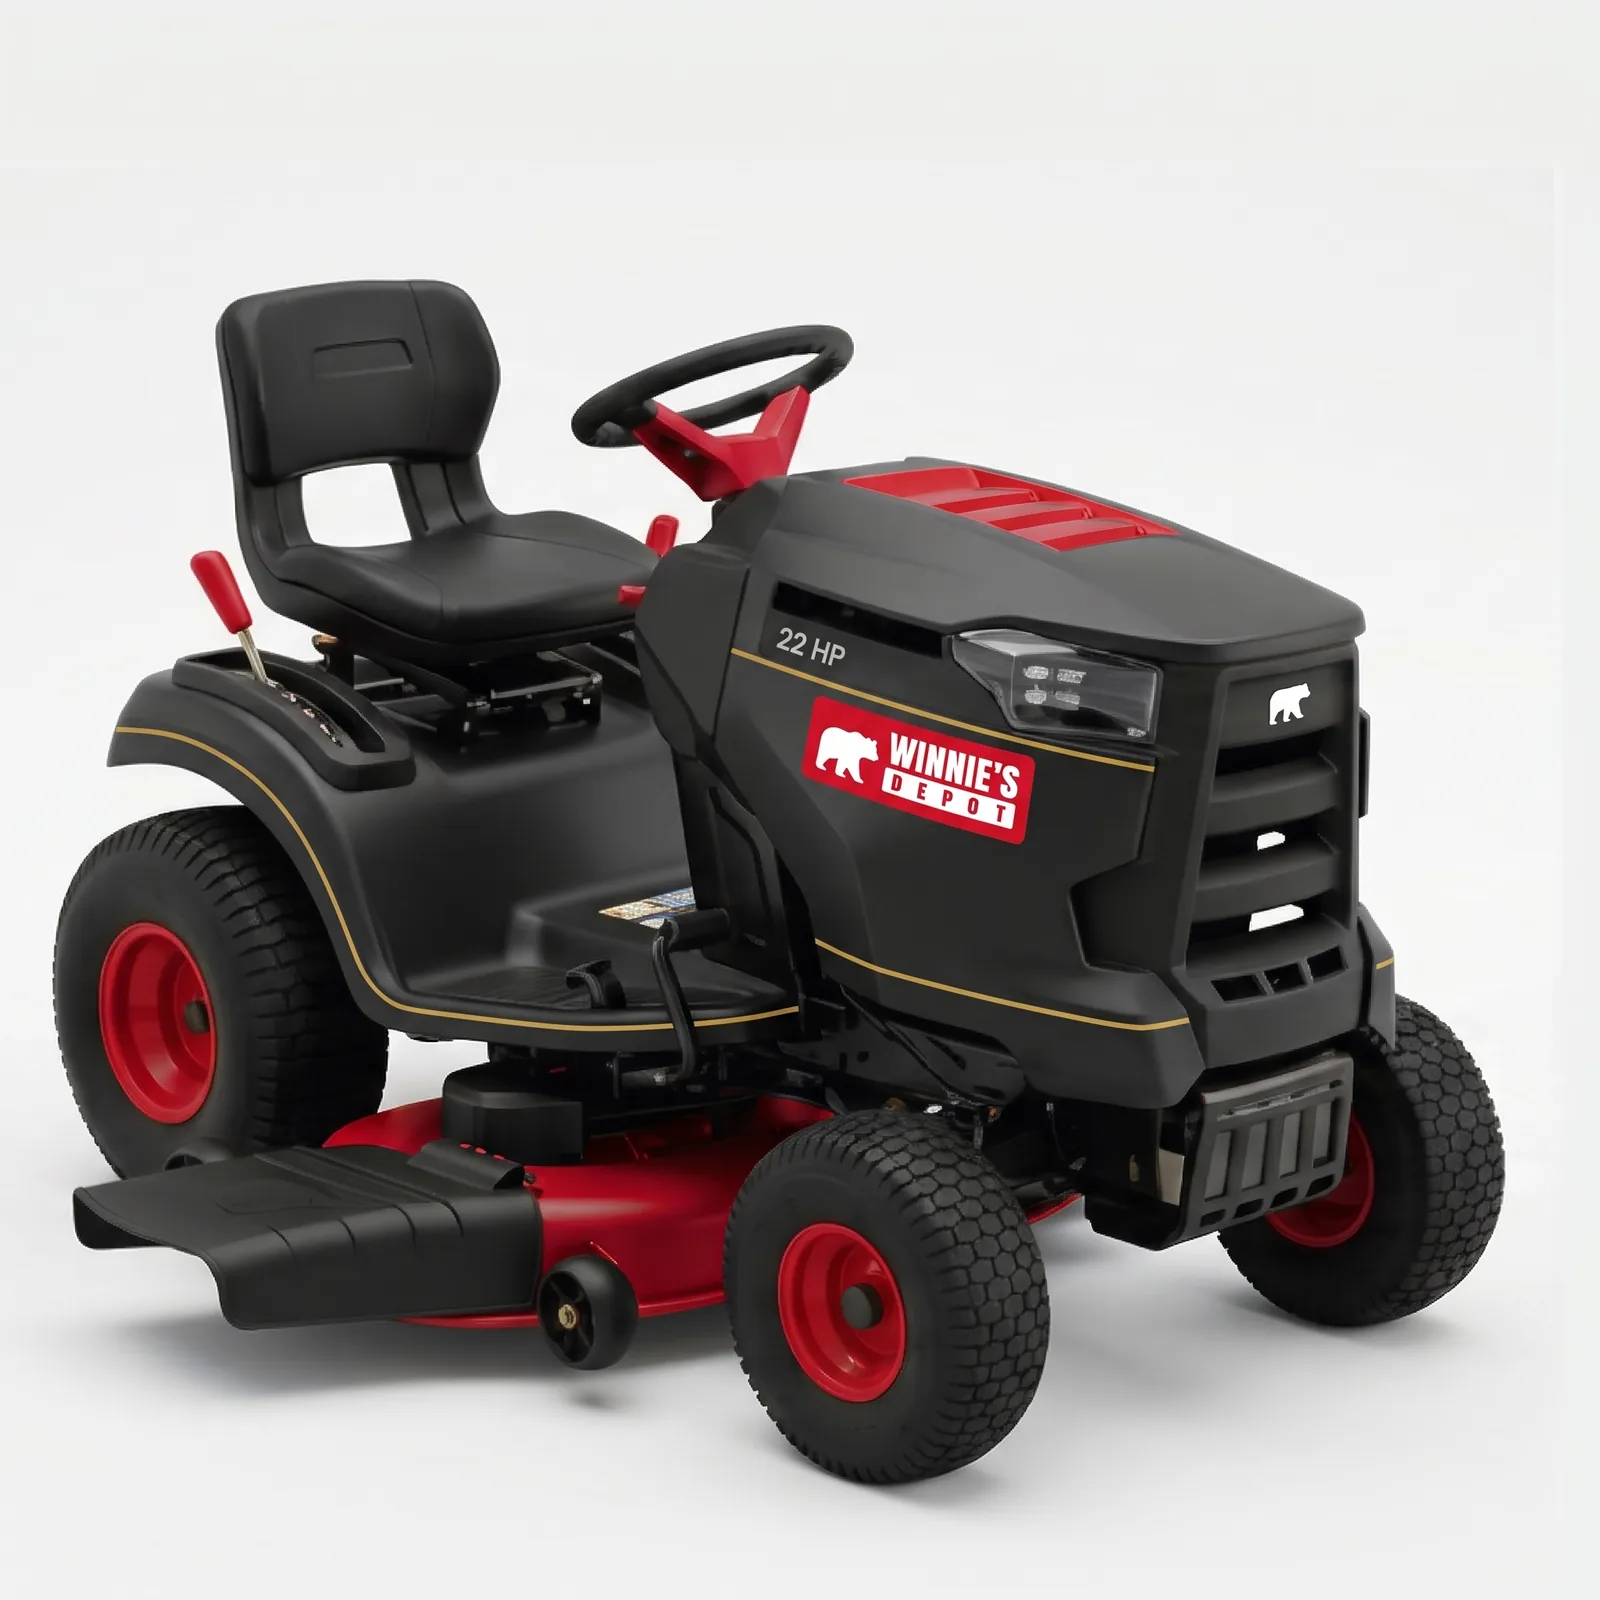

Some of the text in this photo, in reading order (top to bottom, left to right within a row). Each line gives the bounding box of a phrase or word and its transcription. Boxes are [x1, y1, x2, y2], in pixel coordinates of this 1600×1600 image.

[776, 627, 846, 666] 22 HP
[890, 731, 1020, 799] WINNIE'S
[890, 773, 1006, 823] DEPOT
